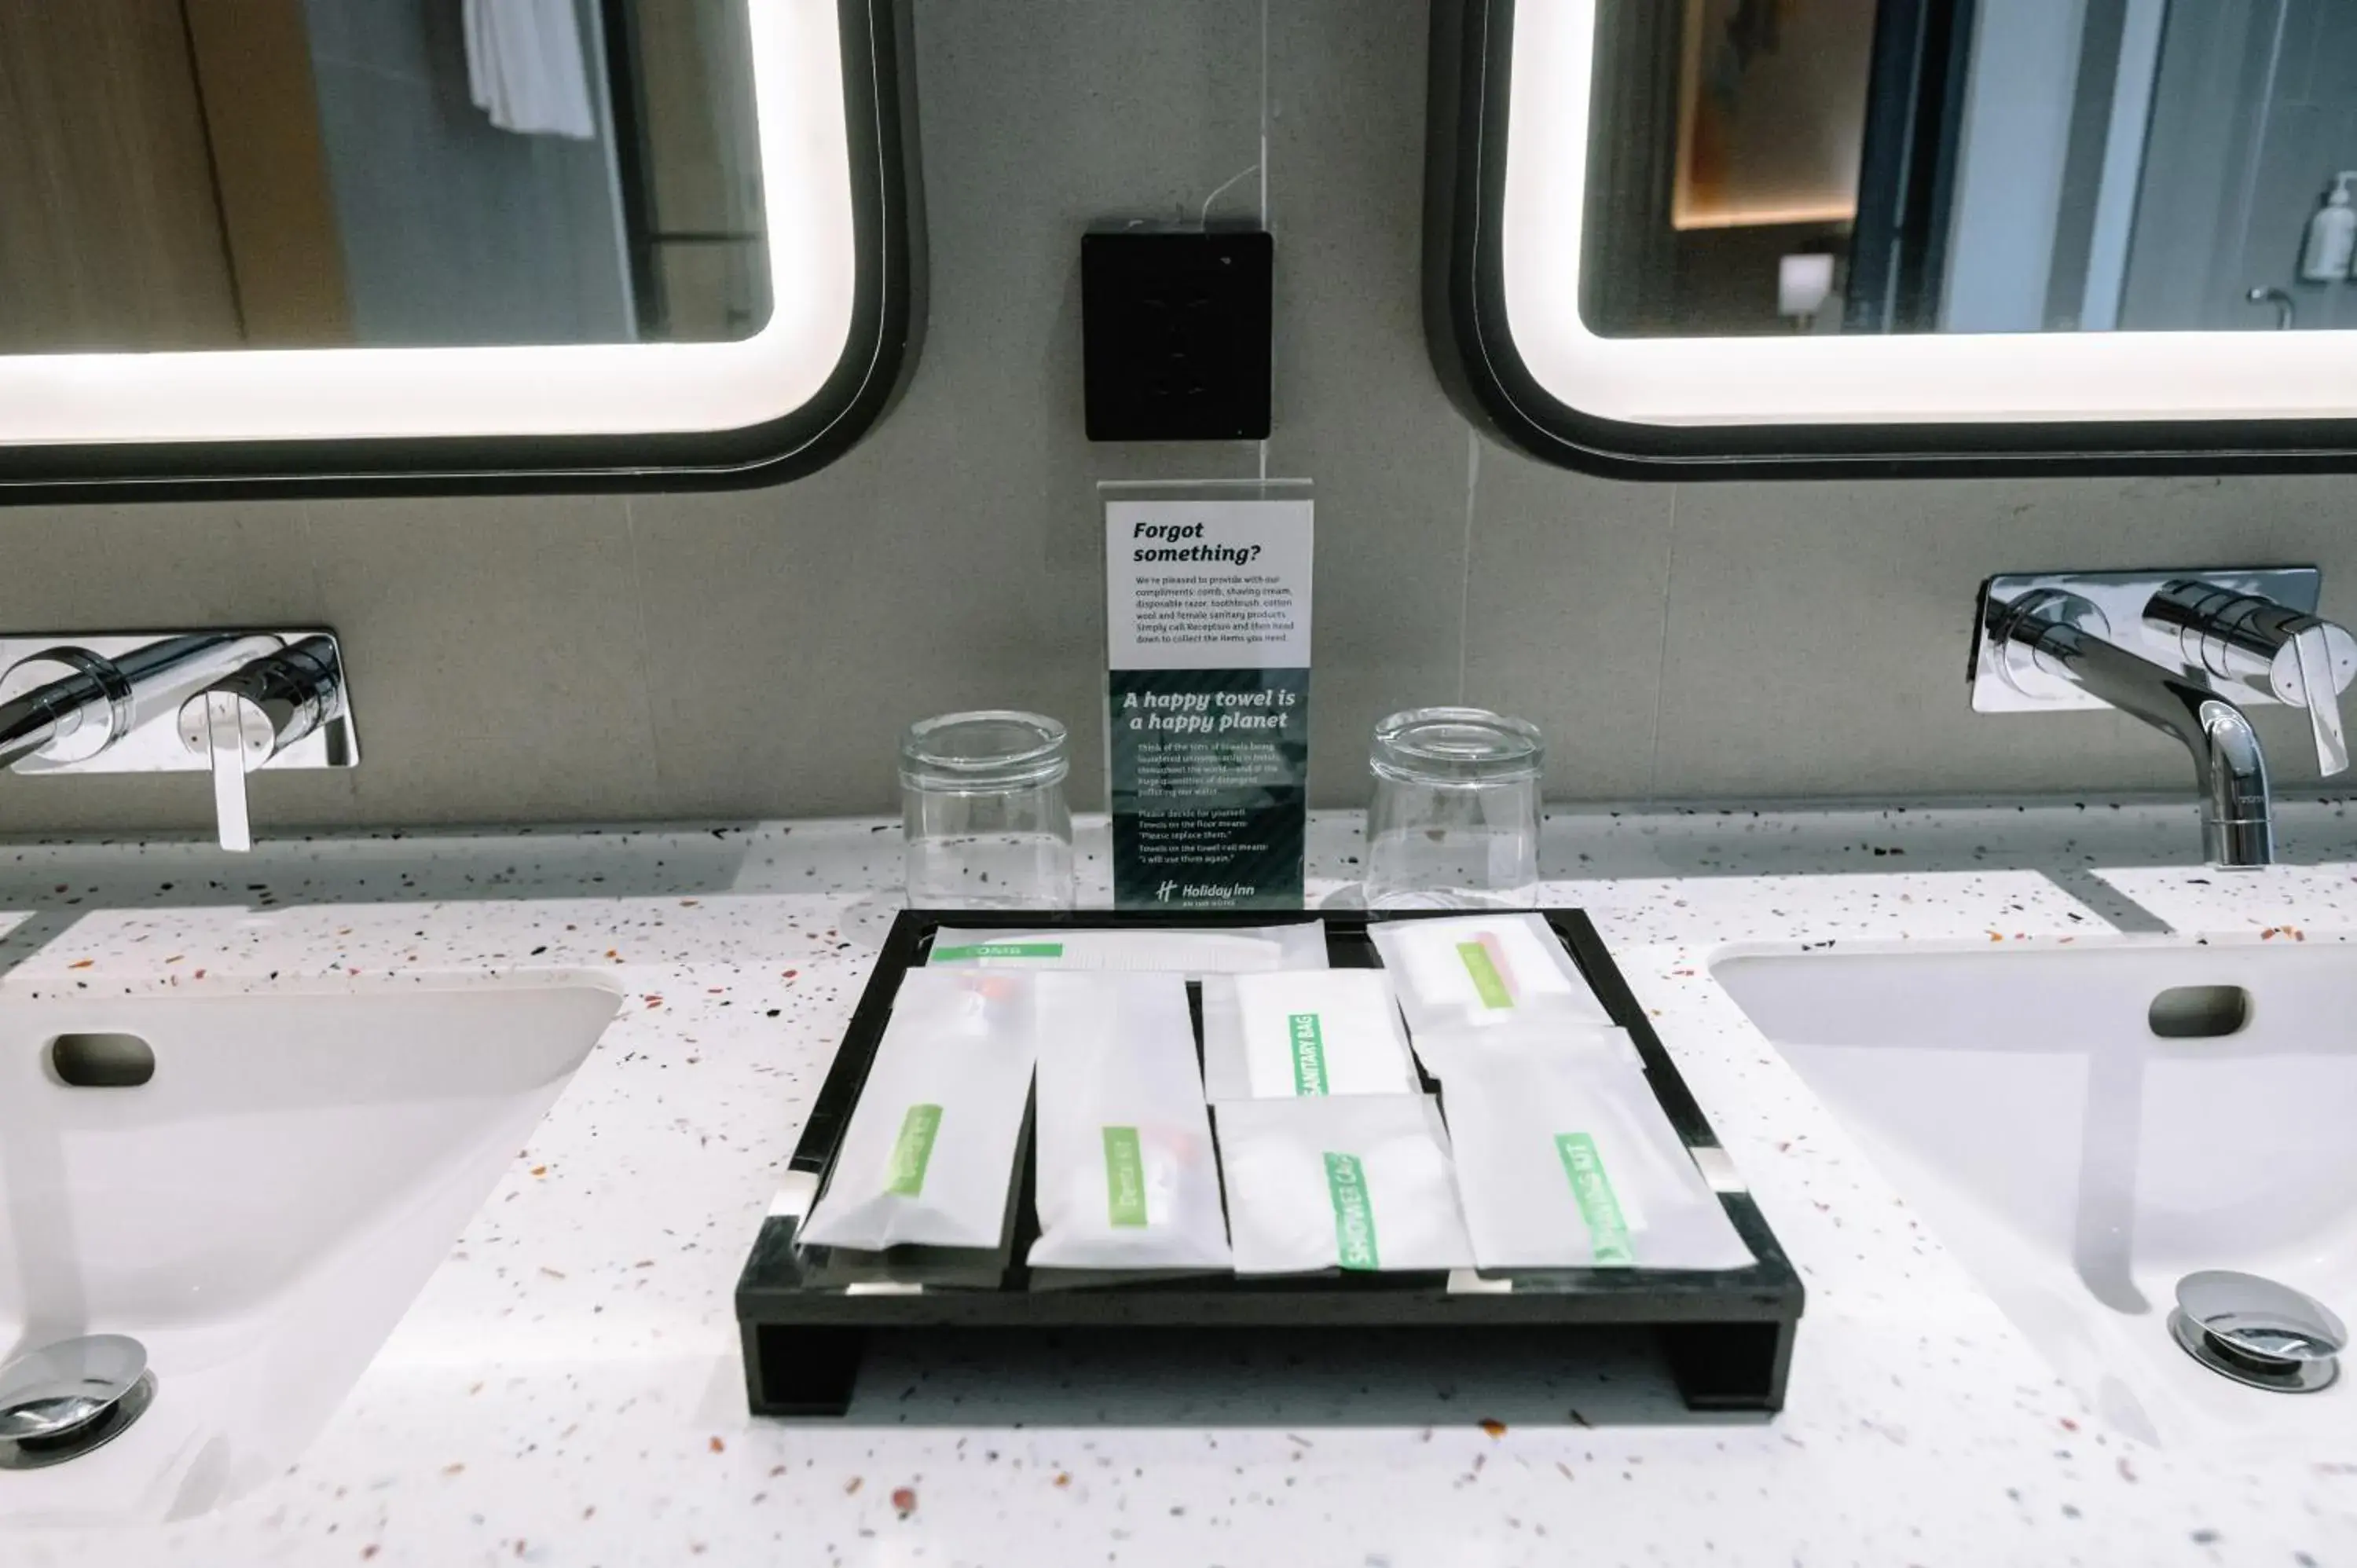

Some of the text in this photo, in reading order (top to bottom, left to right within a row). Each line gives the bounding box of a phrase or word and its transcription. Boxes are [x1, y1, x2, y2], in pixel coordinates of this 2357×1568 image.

[1133, 522, 1204, 543] Forgot
[1133, 544, 1261, 566] something?
[1162, 576, 1197, 585] pleased
[1210, 576, 1242, 585] provide
[1226, 588, 1261, 597] shaving
[1136, 599, 1182, 610] disposable
[1210, 611, 1245, 621] sanitary
[1136, 622, 1167, 632] Simply
[1168, 623, 1186, 632] call
[1186, 622, 1231, 632] Reception
[1233, 622, 1248, 631] and
[1172, 634, 1202, 643] collect
[1246, 634, 1263, 643] you
[1123, 689, 1296, 711] A happy towel is
[1130, 712, 1288, 733] a happy planet
[1171, 831, 1202, 841] replace
[1182, 884, 1233, 899] Holiday
[1233, 882, 1255, 896] Inn
[1294, 1013, 1323, 1097] SANITARY BAG
